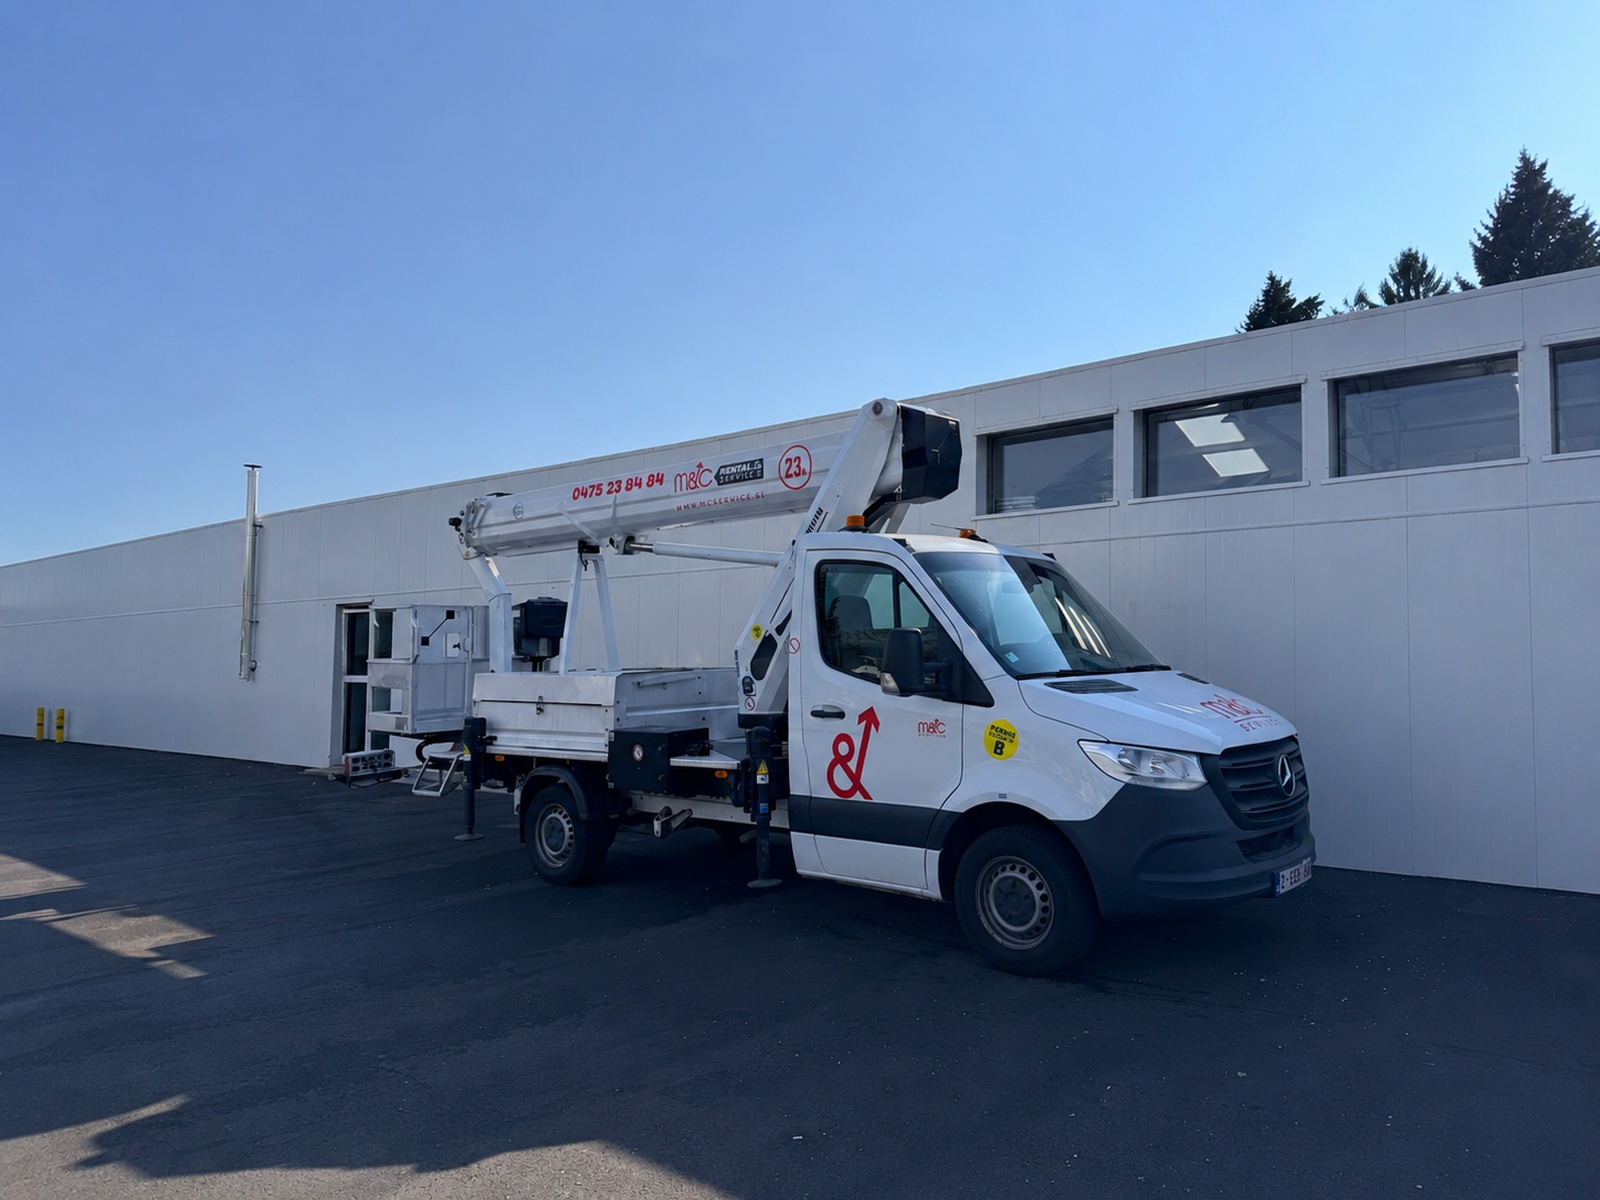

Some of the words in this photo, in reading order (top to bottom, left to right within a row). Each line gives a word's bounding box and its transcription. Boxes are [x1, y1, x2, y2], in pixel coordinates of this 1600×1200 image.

[719, 463, 751, 475] RENTAL
[572, 483, 603, 501] 0475
[606, 479, 623, 495] 23
[624, 476, 643, 492] 84
[645, 472, 665, 488] 84
[993, 740, 1005, 756] B
